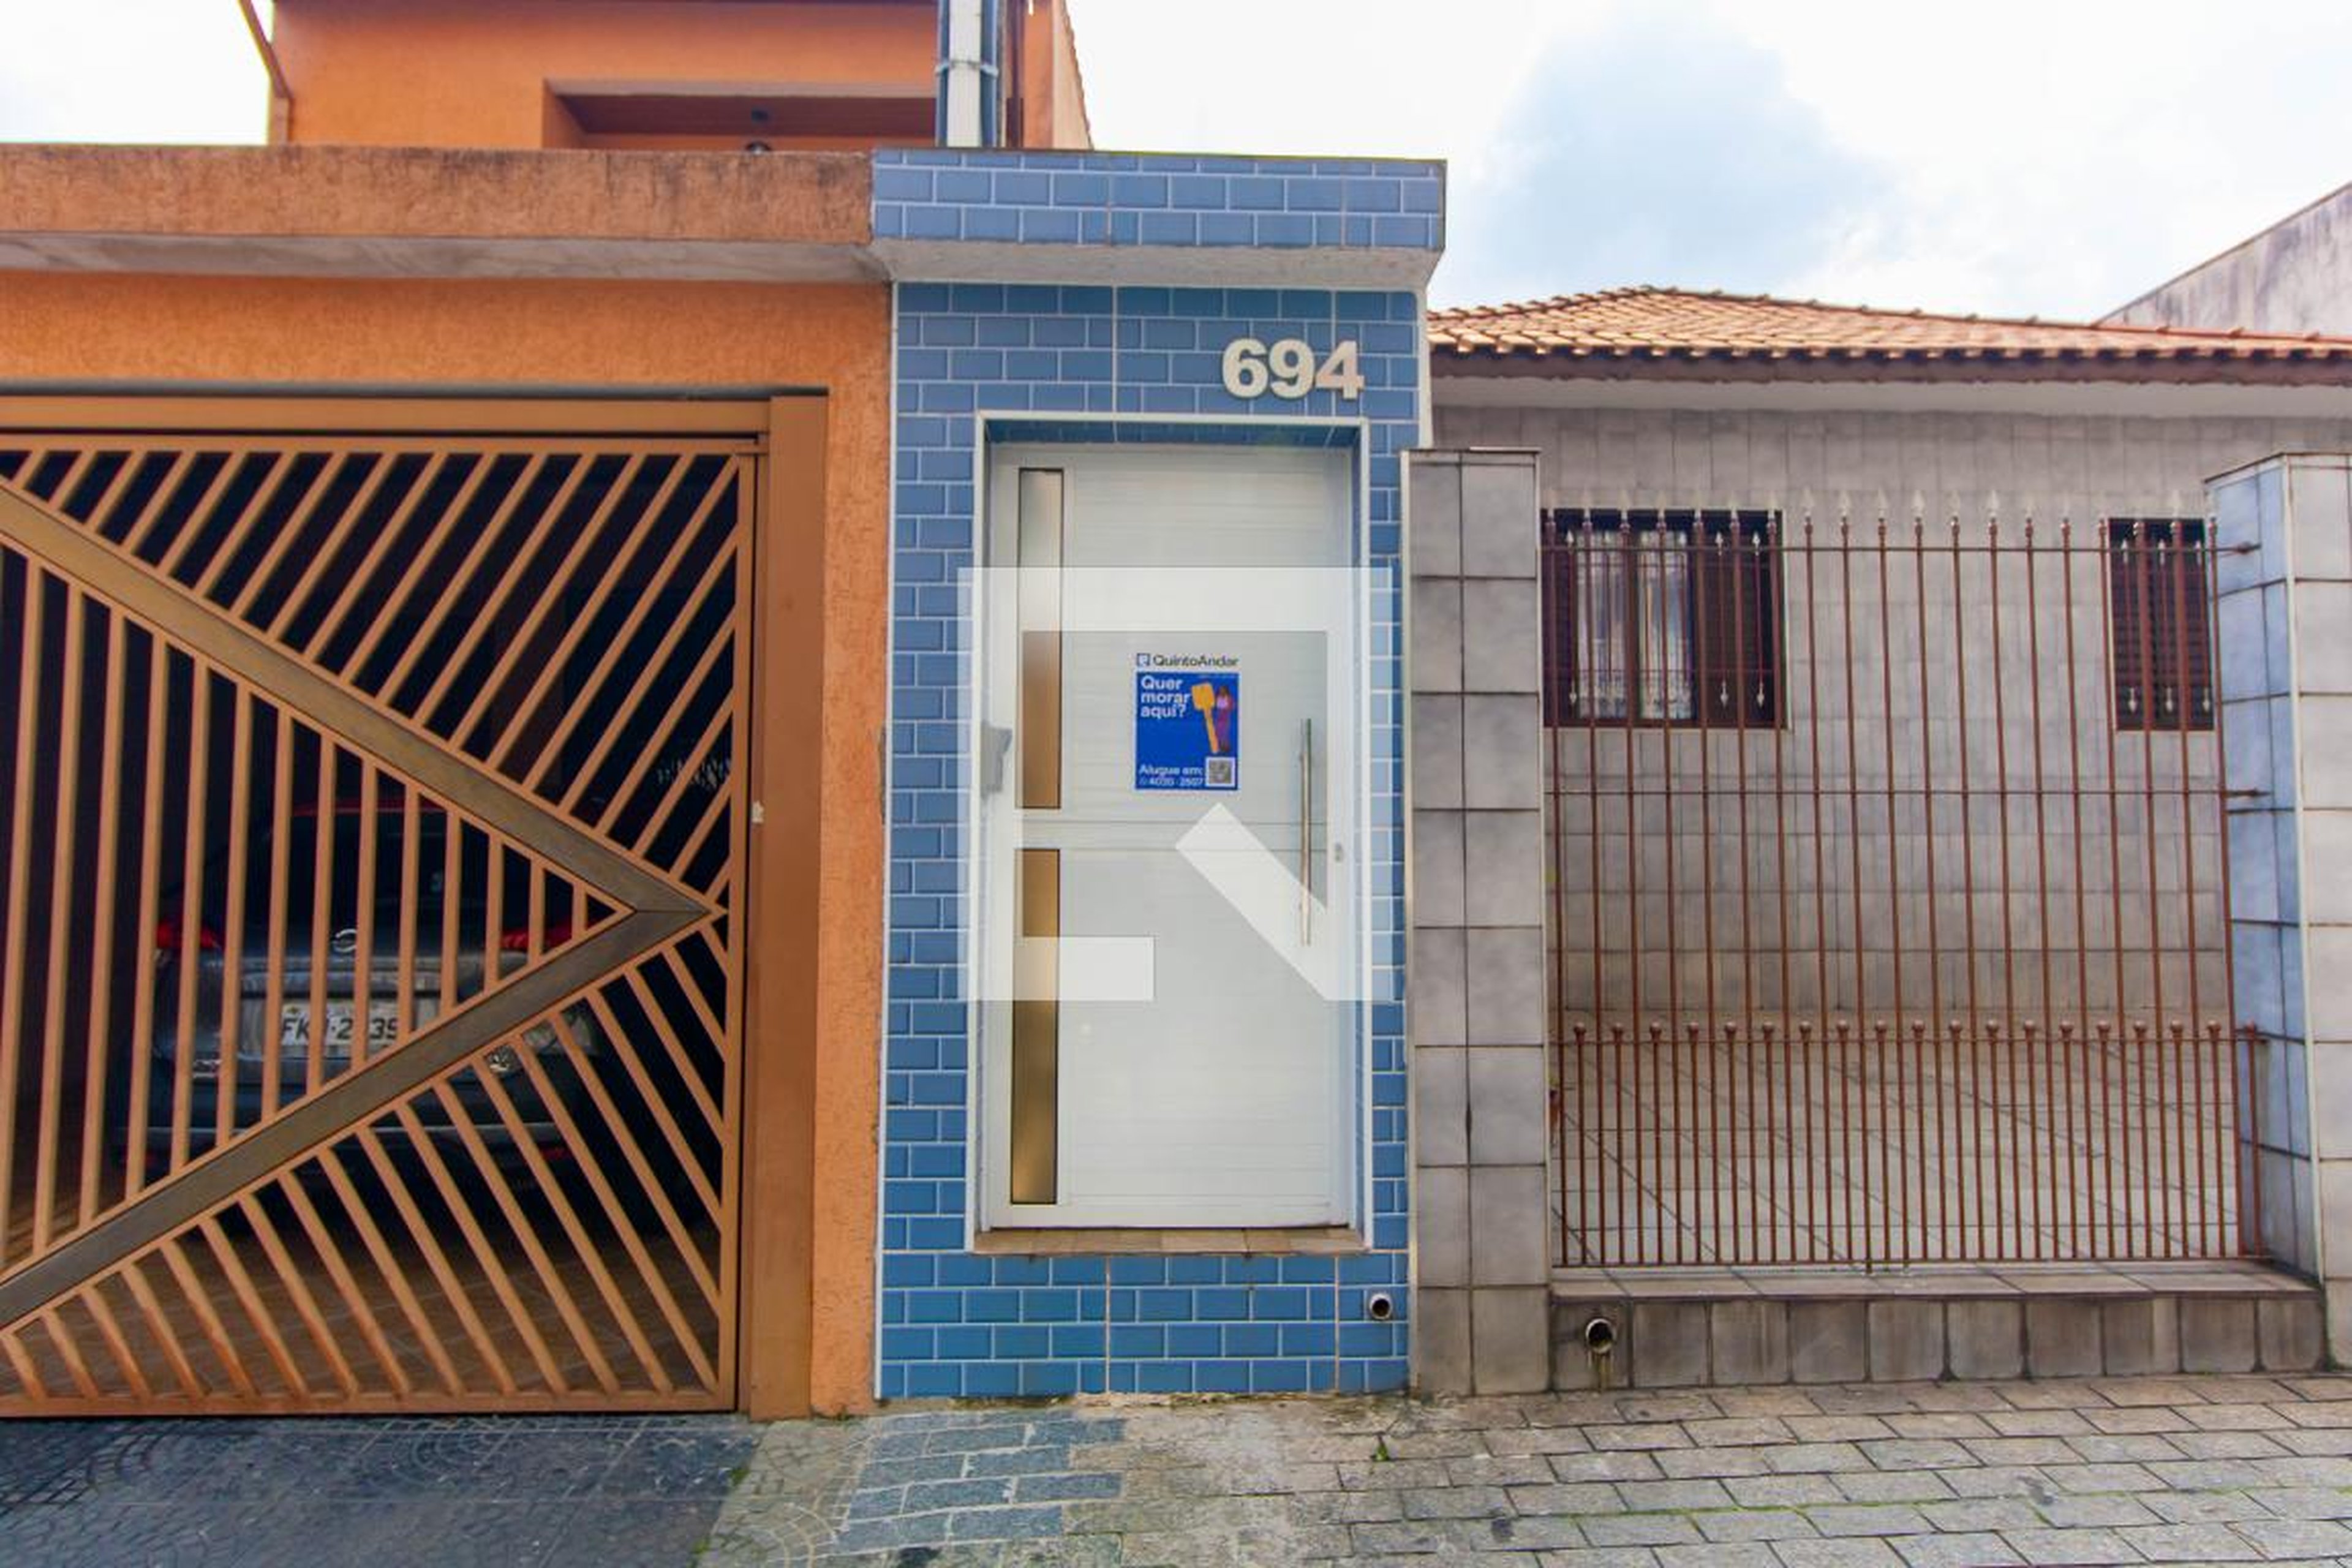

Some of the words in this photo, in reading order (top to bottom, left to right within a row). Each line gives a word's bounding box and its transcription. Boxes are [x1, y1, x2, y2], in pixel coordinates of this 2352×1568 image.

[1223, 338, 1365, 399] 694
[1153, 654, 1238, 666] QuintoAndar
[1141, 675, 1183, 690] Quer
[1141, 693, 1190, 703] morar
[1140, 704, 1186, 719] aqui?
